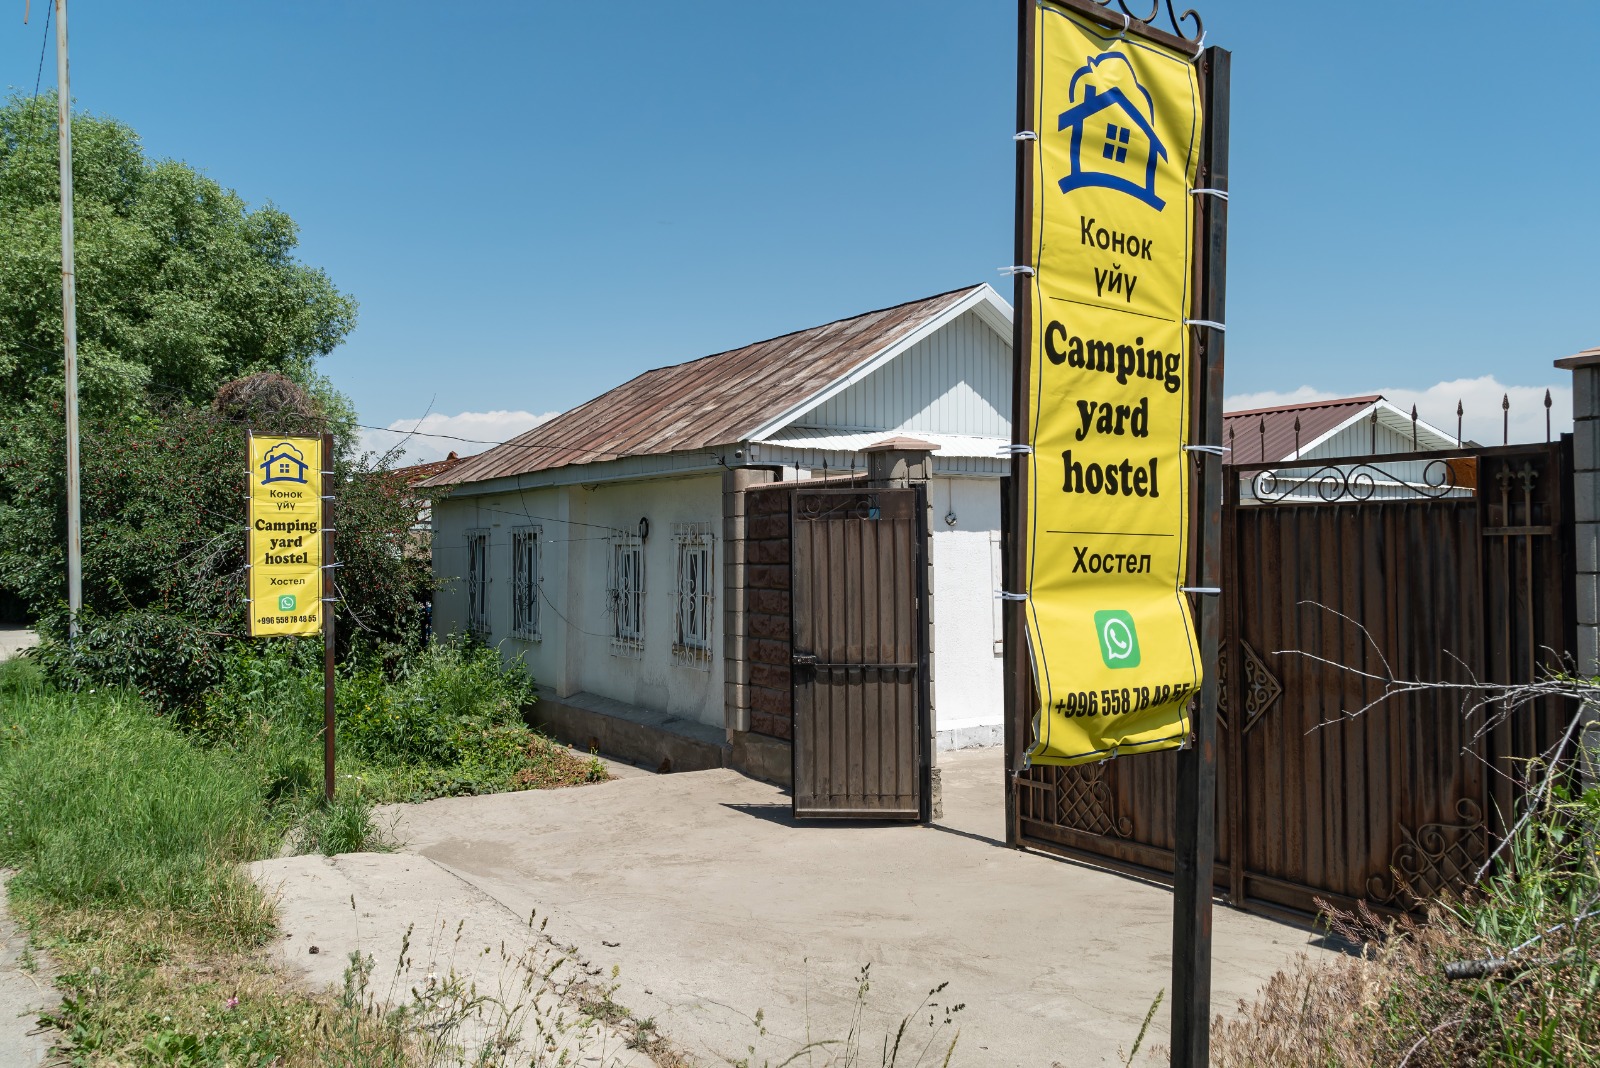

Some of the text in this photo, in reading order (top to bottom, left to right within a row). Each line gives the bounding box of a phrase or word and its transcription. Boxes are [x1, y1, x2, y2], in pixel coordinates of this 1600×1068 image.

[1080, 215, 1153, 261] Конок
[1044, 320, 1181, 393] Camping
[1075, 397, 1149, 441] yard
[1061, 449, 1159, 498] hostel
[269, 489, 303, 498] Конок
[255, 519, 317, 533] Camping
[270, 535, 303, 550] yard
[265, 552, 308, 565] hostel
[1071, 546, 1151, 573] Хостел
[270, 577, 306, 586] Хостел
[257, 614, 317, 625] +996 558 78 48 55
[1055, 690, 1098, 718] +996
[1101, 688, 1130, 716] 558
[1133, 686, 1150, 712] 78
[1151, 684, 1171, 708] 48
